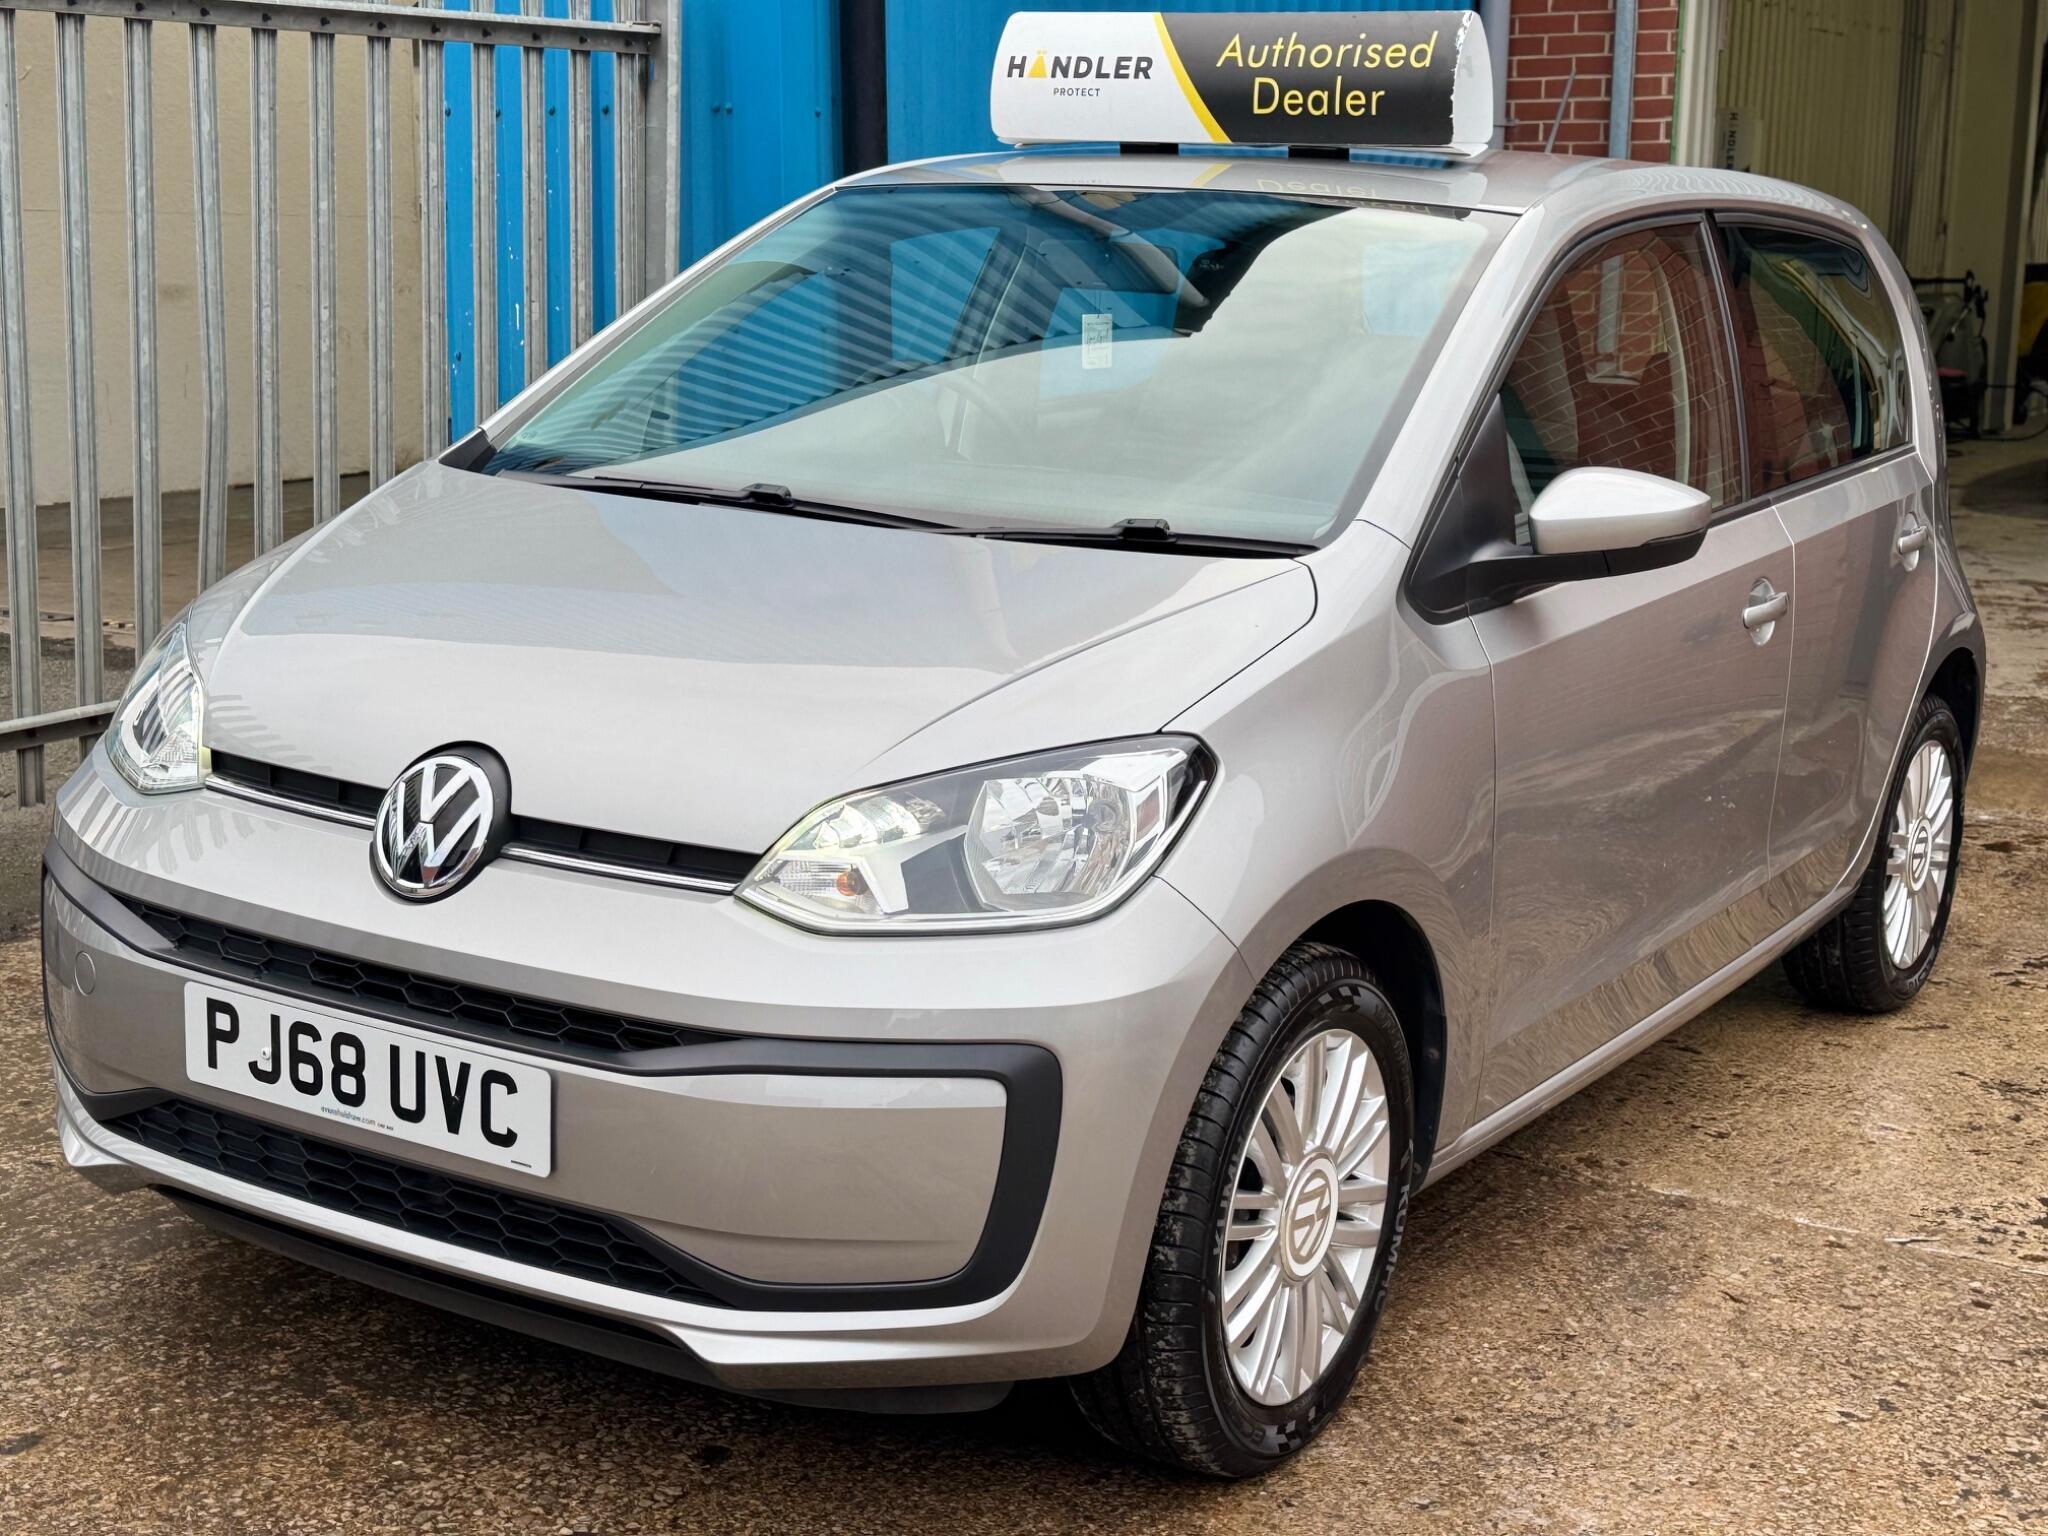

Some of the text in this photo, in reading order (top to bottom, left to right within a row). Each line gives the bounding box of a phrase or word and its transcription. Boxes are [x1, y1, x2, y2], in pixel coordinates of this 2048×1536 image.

[1215, 30, 1439, 69] Authorised
[1053, 87, 1101, 97] PROTECT
[1252, 75, 1386, 116] Dealer
[206, 996, 519, 1149] PJ68 UVC
